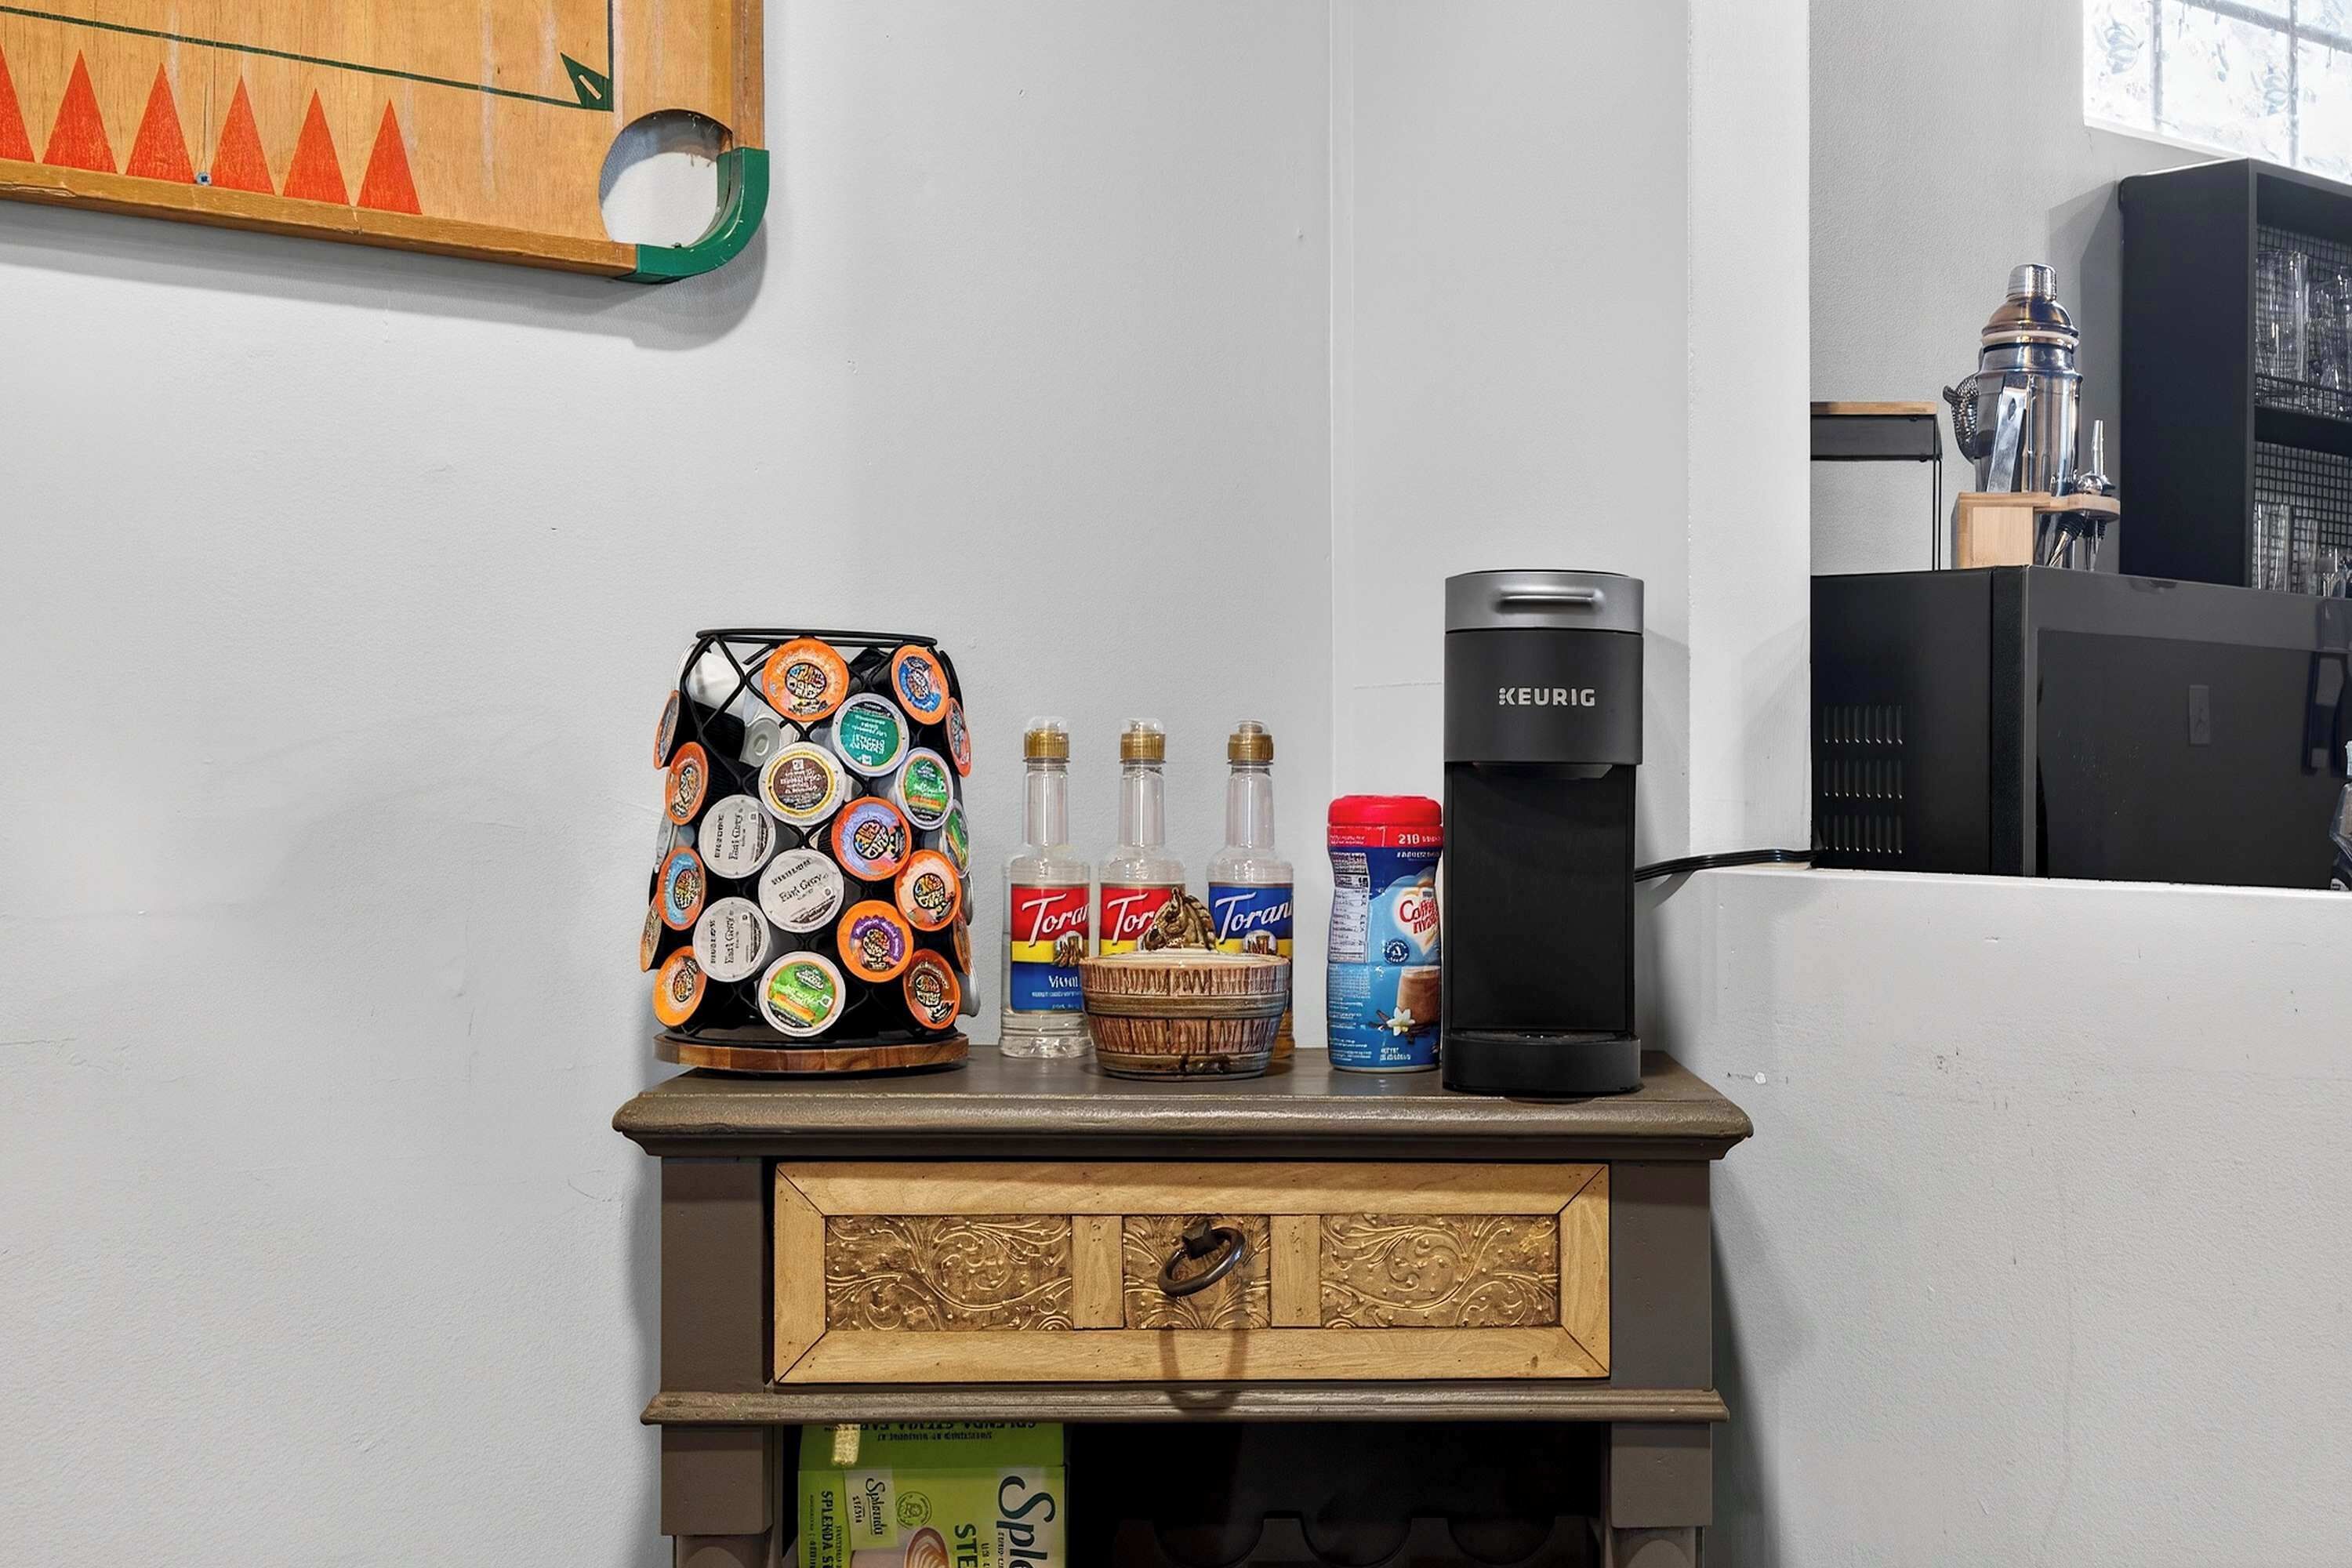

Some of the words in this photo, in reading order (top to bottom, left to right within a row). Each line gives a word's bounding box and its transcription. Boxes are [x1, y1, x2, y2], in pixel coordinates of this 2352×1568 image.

[1499, 687, 1595, 706] KEURIG
[779, 884, 800, 903] Earl
[1022, 893, 1089, 946] Tora
[1107, 891, 1155, 945] Tor
[1215, 891, 1292, 943] Toran
[821, 1490, 833, 1551] SPLENDA
